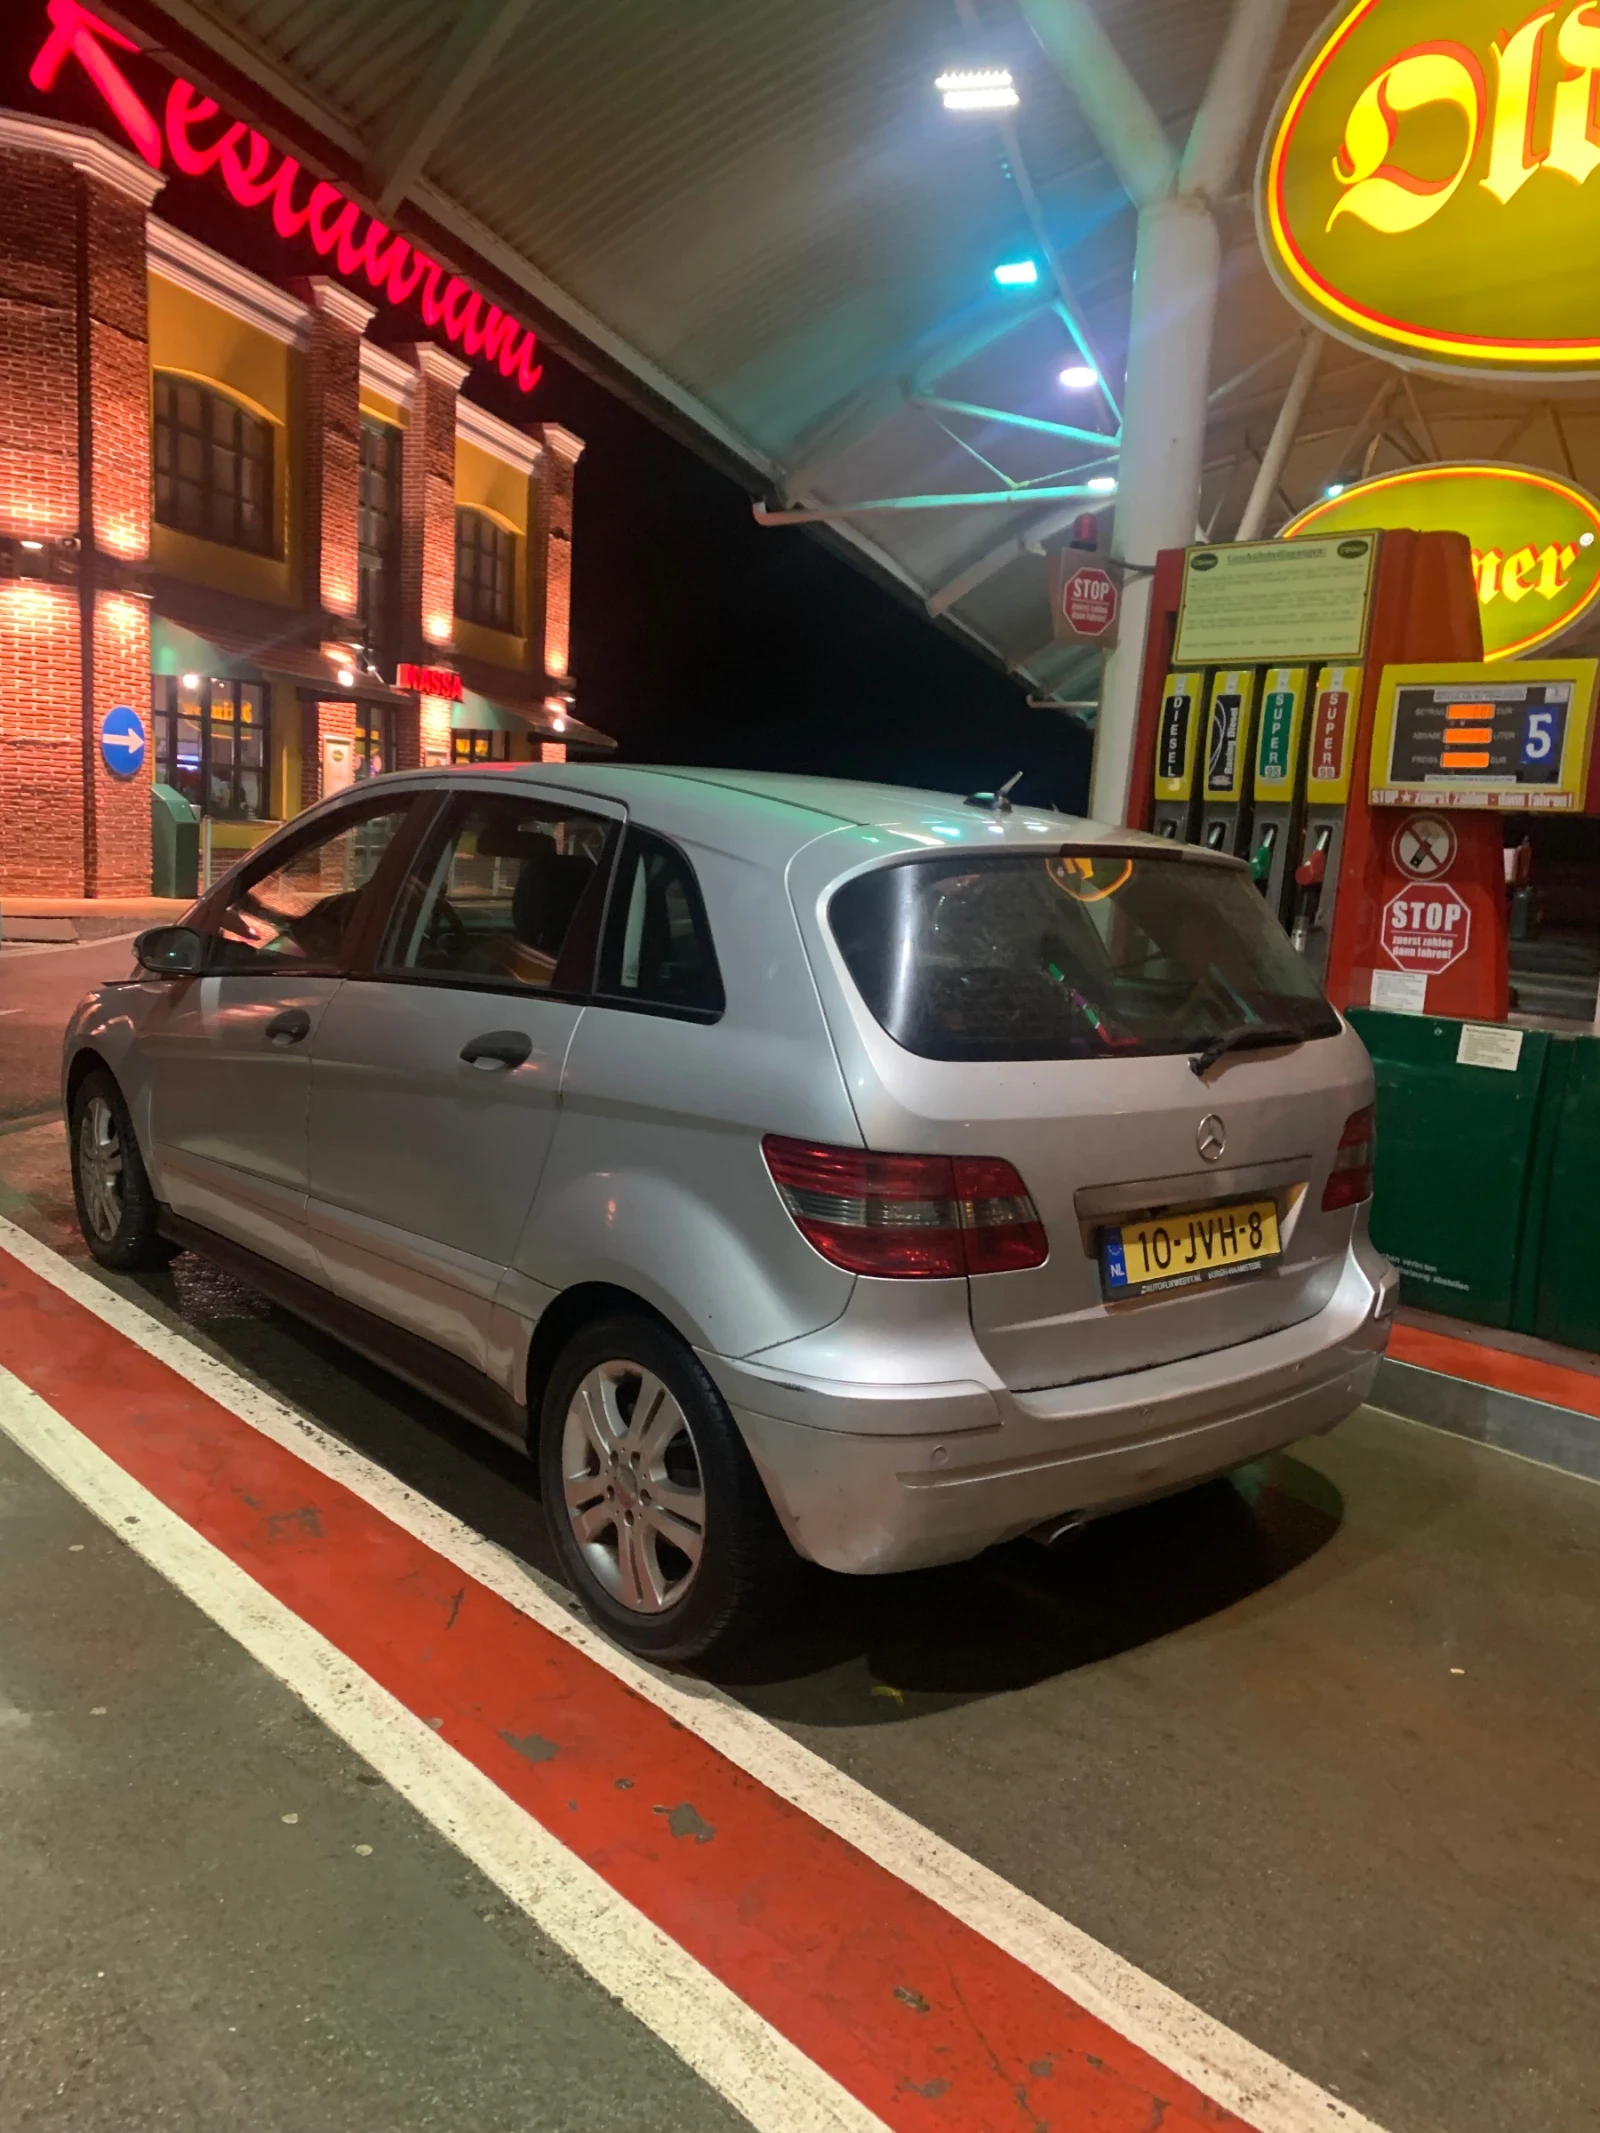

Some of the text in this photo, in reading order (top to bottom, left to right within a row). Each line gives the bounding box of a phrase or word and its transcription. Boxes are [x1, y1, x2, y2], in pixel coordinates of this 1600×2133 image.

[1072, 577, 1110, 601] STOP
[406, 664, 463, 700] KASSA
[1168, 697, 1182, 777] DIESEL
[1227, 707, 1239, 738] Diesel
[1269, 693, 1285, 764] SUPER
[1323, 693, 1339, 764] SUPER
[1525, 713, 1552, 758] 5
[1371, 790, 1399, 805] STOP
[1391, 900, 1461, 931] STOP
[1392, 935, 1454, 948] zuerst zahlen
[1392, 946, 1452, 959] dann fahren!
[1138, 1211, 1263, 1272] 10-JVH-8
[1110, 1263, 1125, 1278] NL
